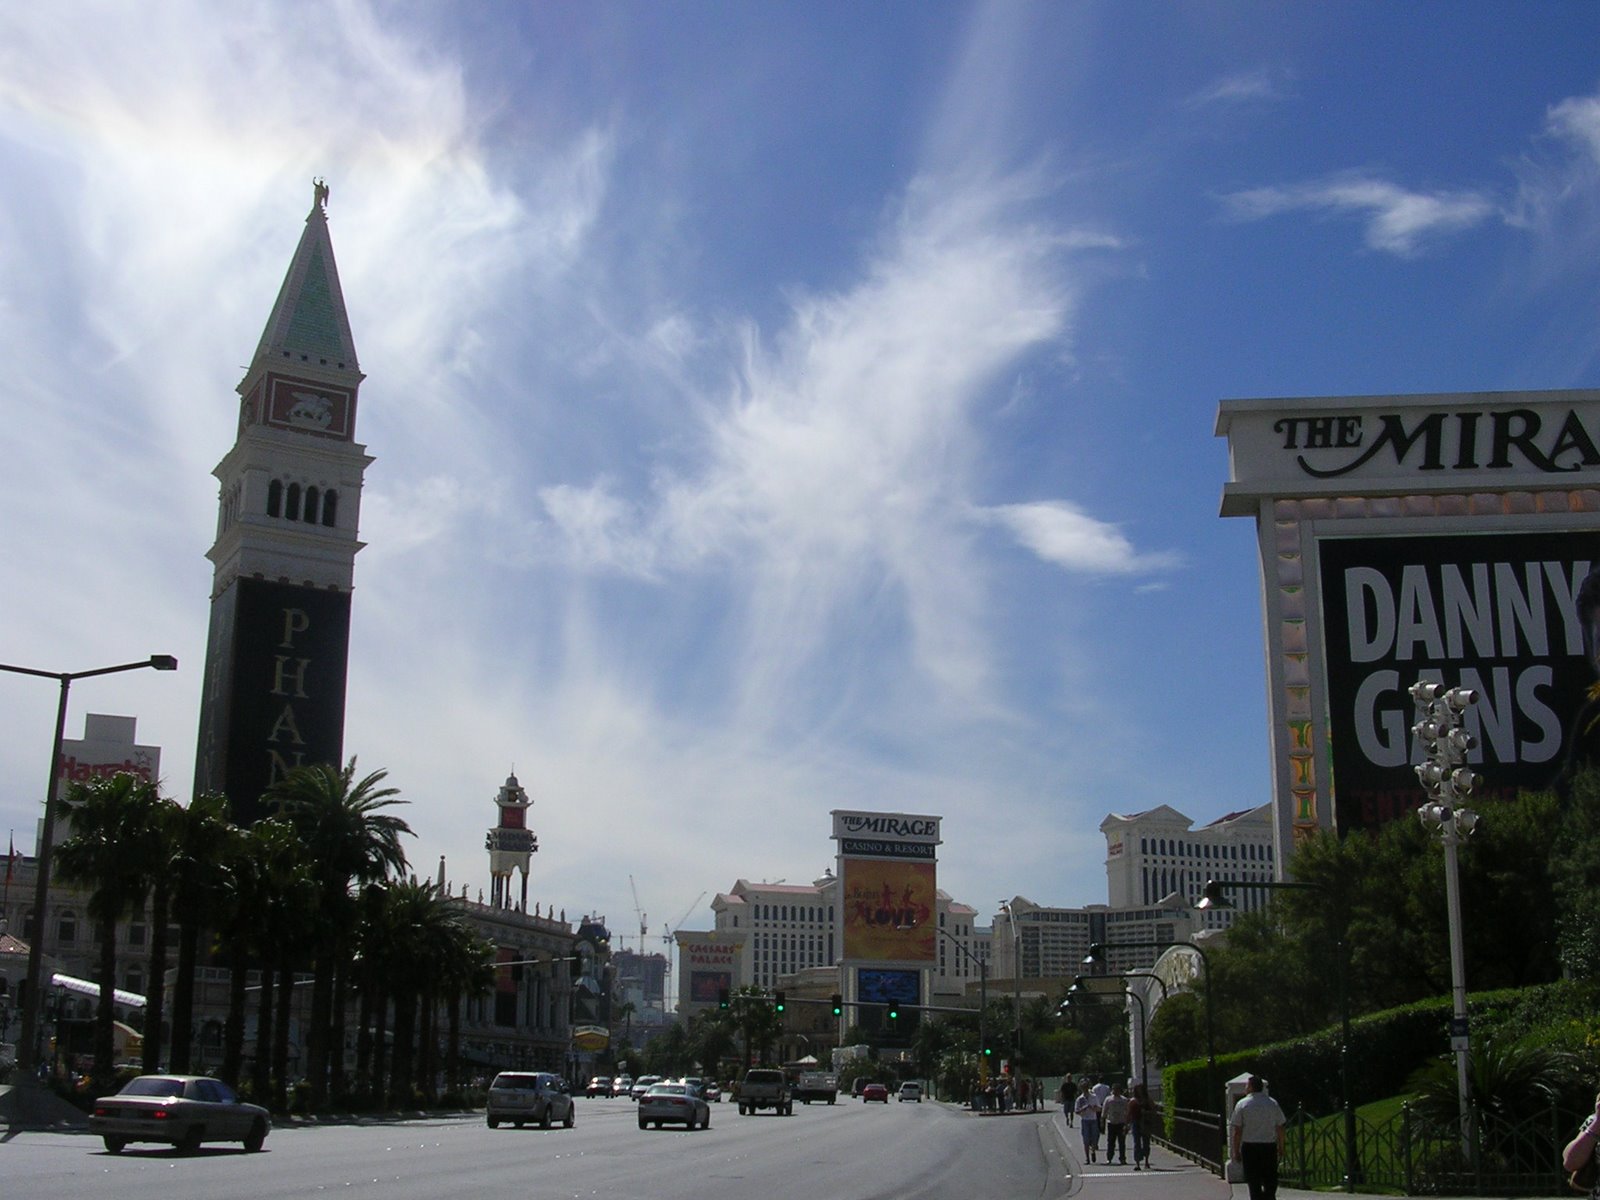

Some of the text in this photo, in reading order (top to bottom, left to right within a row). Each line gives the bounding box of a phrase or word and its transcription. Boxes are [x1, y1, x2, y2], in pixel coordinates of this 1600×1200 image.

[1274, 408, 1600, 478] THE MIRA
[1344, 560, 1592, 663] DANNY
[841, 815, 936, 836] THE MIRAGE
[844, 841, 882, 851] CASINO
[894, 845, 933, 855] RESORT
[690, 955, 732, 965] PALACE
